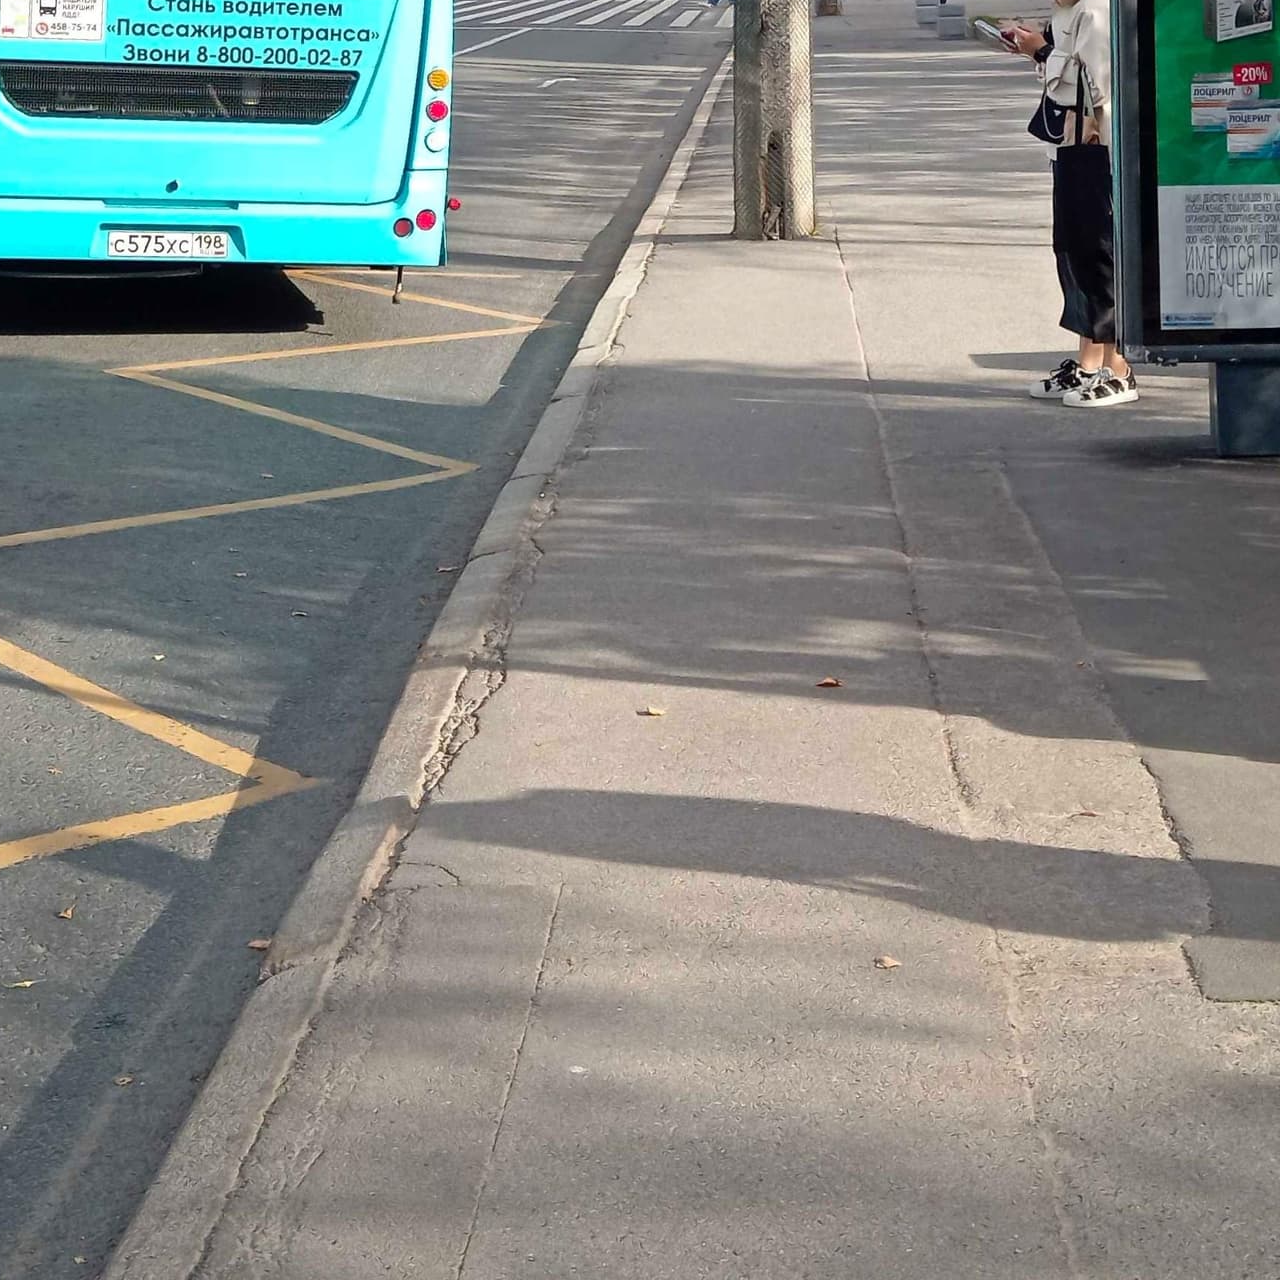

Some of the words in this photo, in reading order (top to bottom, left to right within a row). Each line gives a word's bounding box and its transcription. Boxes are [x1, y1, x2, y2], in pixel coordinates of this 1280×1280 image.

[222, 0, 343, 17] водителем
[106, 19, 380, 44] «Пассажиравтотранса»
[123, 44, 190, 63] Звони
[196, 46, 363, 67] 8-800-200-02-87
[1236, 66, 1268, 82] -20%
[114, 234, 189, 254] С575ХС
[194, 235, 223, 250] 198
[1185, 244, 1256, 271] ИМЕЮТСЯ
[1185, 271, 1274, 298] ПОЛУЧЕНИЕ
